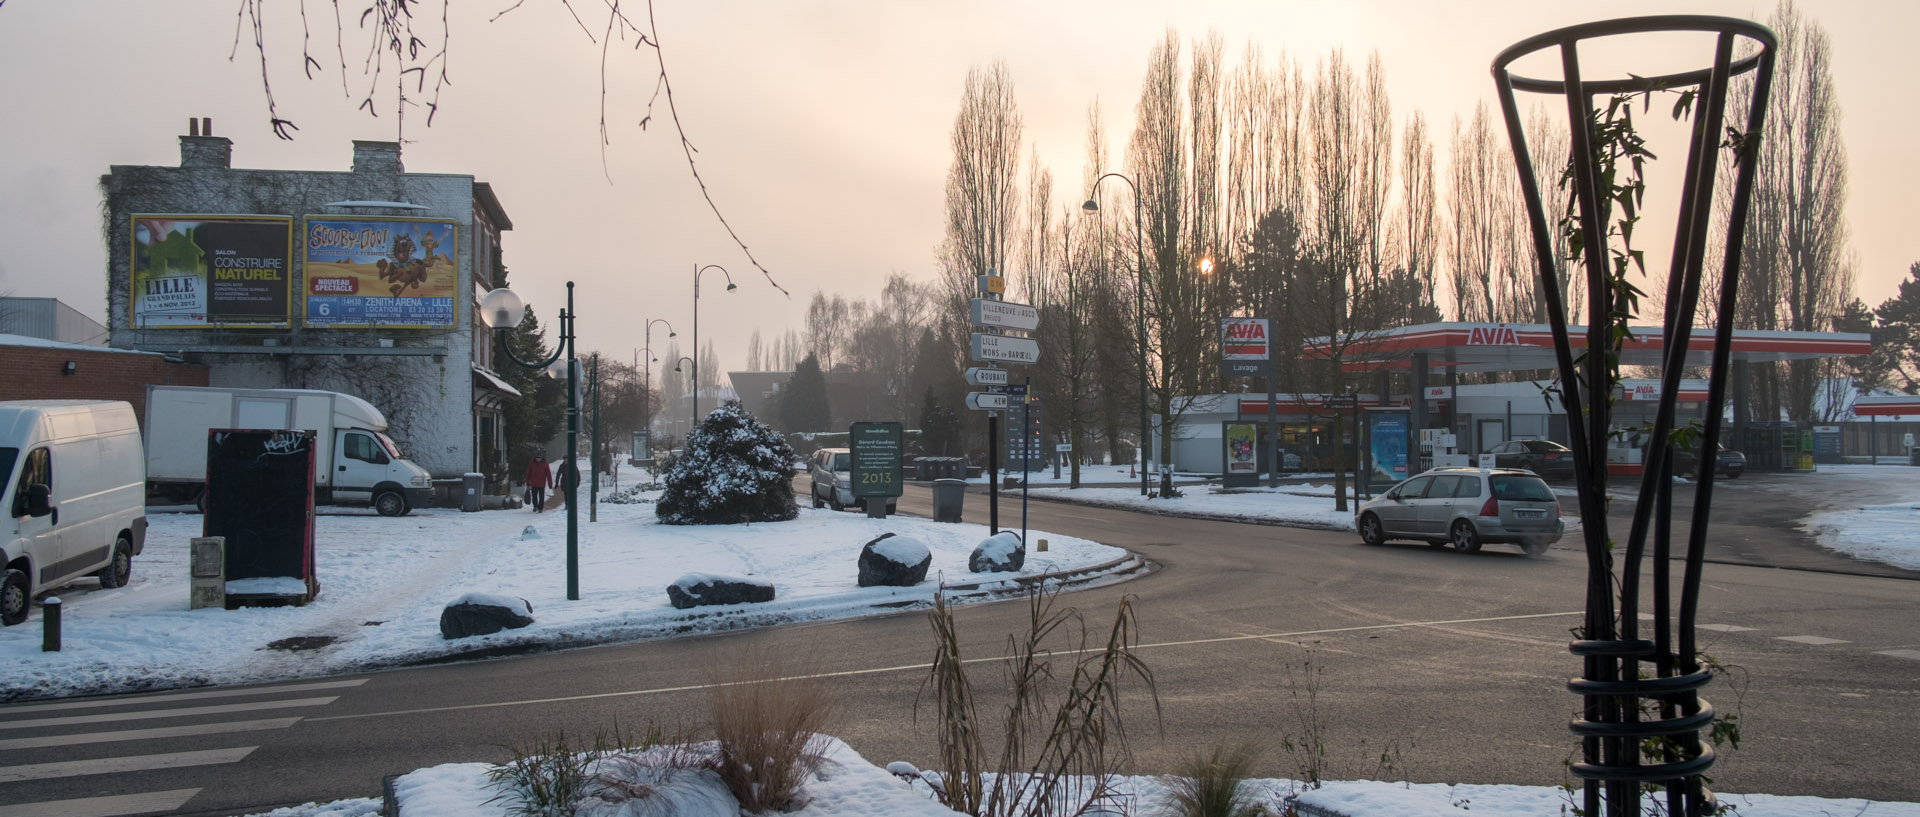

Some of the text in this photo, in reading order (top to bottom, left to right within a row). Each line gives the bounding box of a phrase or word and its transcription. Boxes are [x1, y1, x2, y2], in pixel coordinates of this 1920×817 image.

[215, 258, 282, 269] CONSTRUIRE
[215, 269, 282, 281] NATUREL
[145, 277, 194, 295] LILLE
[171, 293, 196, 301] PALAIS
[366, 297, 394, 306] ZENITH
[395, 298, 422, 306] ARENA
[432, 298, 453, 307] LILLE
[319, 303, 330, 316] 6
[982, 303, 1016, 316] VILLENEUVE
[1225, 320, 1265, 338] AVIA
[1470, 323, 1516, 345] AVIA
[982, 337, 998, 346] LILLE
[982, 348, 1000, 358] MONS
[1233, 364, 1258, 373] Lavage
[981, 372, 1006, 381] ROUBAIX
[1635, 384, 1654, 394] AVIA
[994, 397, 1006, 405] HEM
[862, 472, 892, 484] 2013
